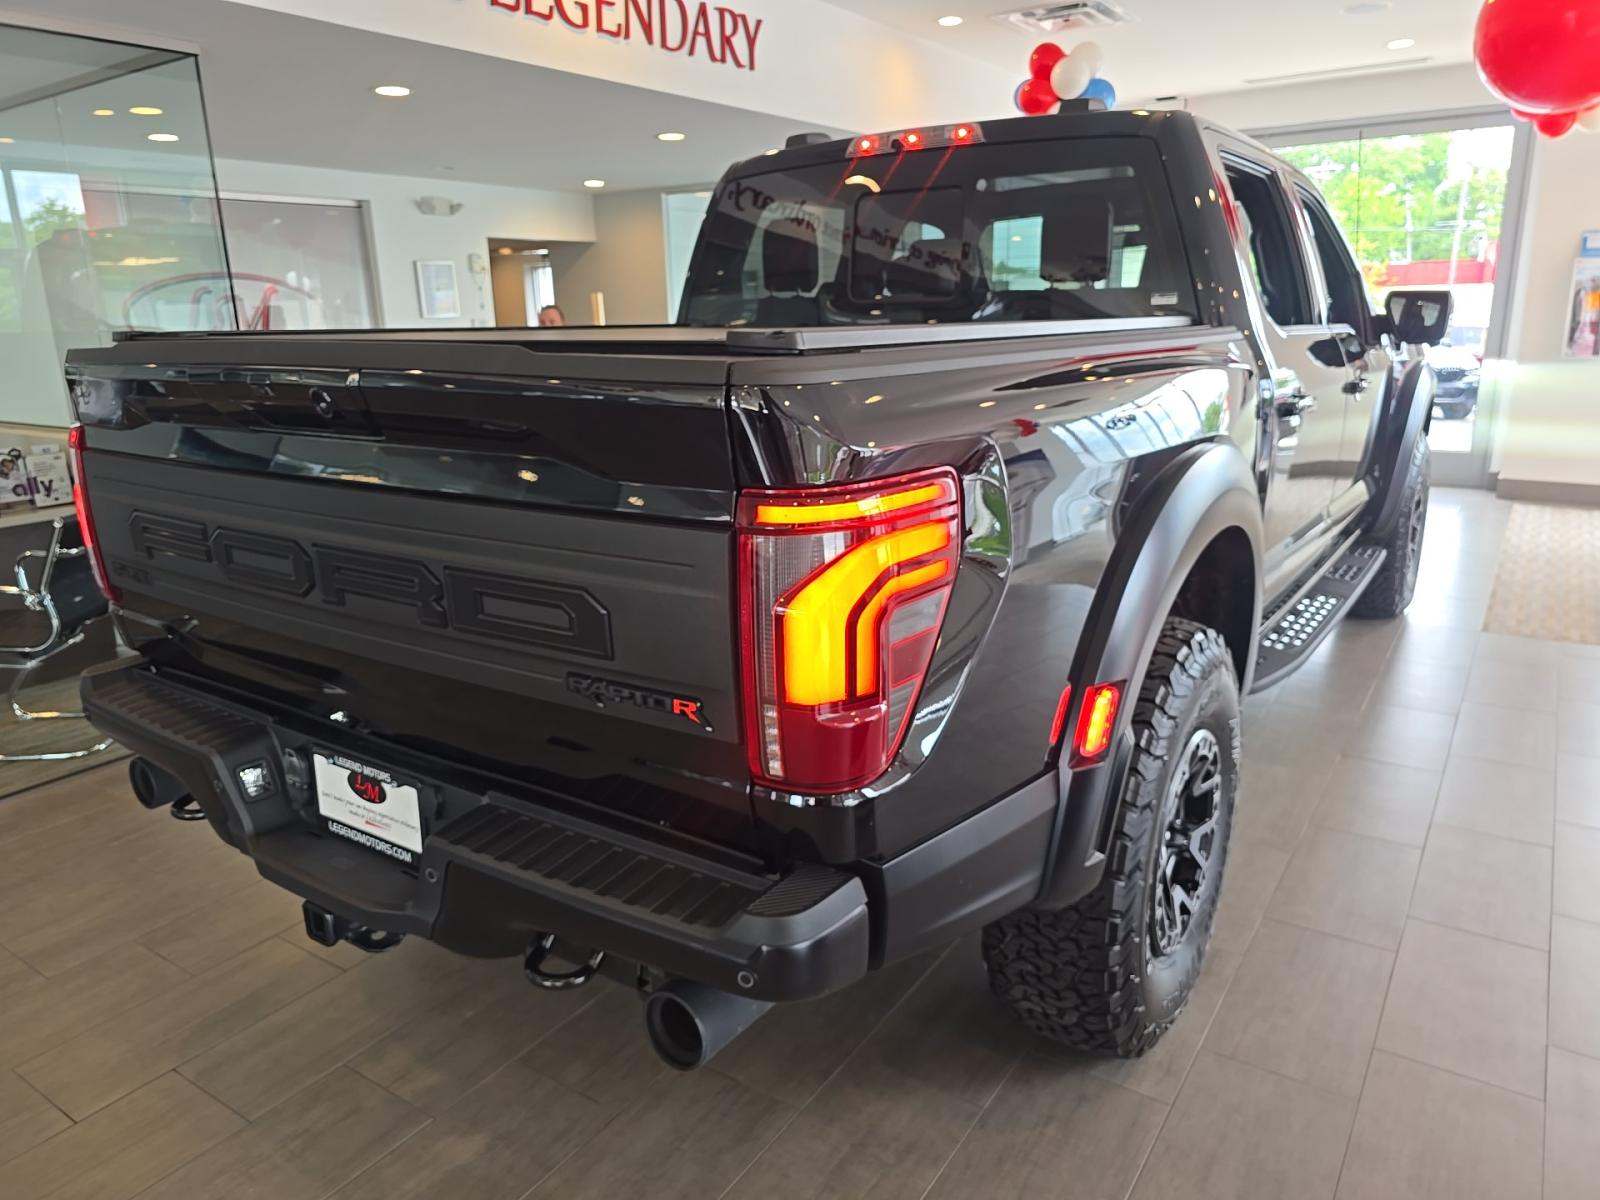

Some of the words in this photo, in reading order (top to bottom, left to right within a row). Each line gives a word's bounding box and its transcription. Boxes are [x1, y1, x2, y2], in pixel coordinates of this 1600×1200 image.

[489, 0, 762, 71] GENDARY
[128, 510, 615, 661] FORD
[566, 674, 700, 724] RAPTOR
[334, 756, 362, 773] LEGEND
[363, 765, 391, 782] MOTORS
[328, 820, 412, 863] LEGENDMOTORS.COM
